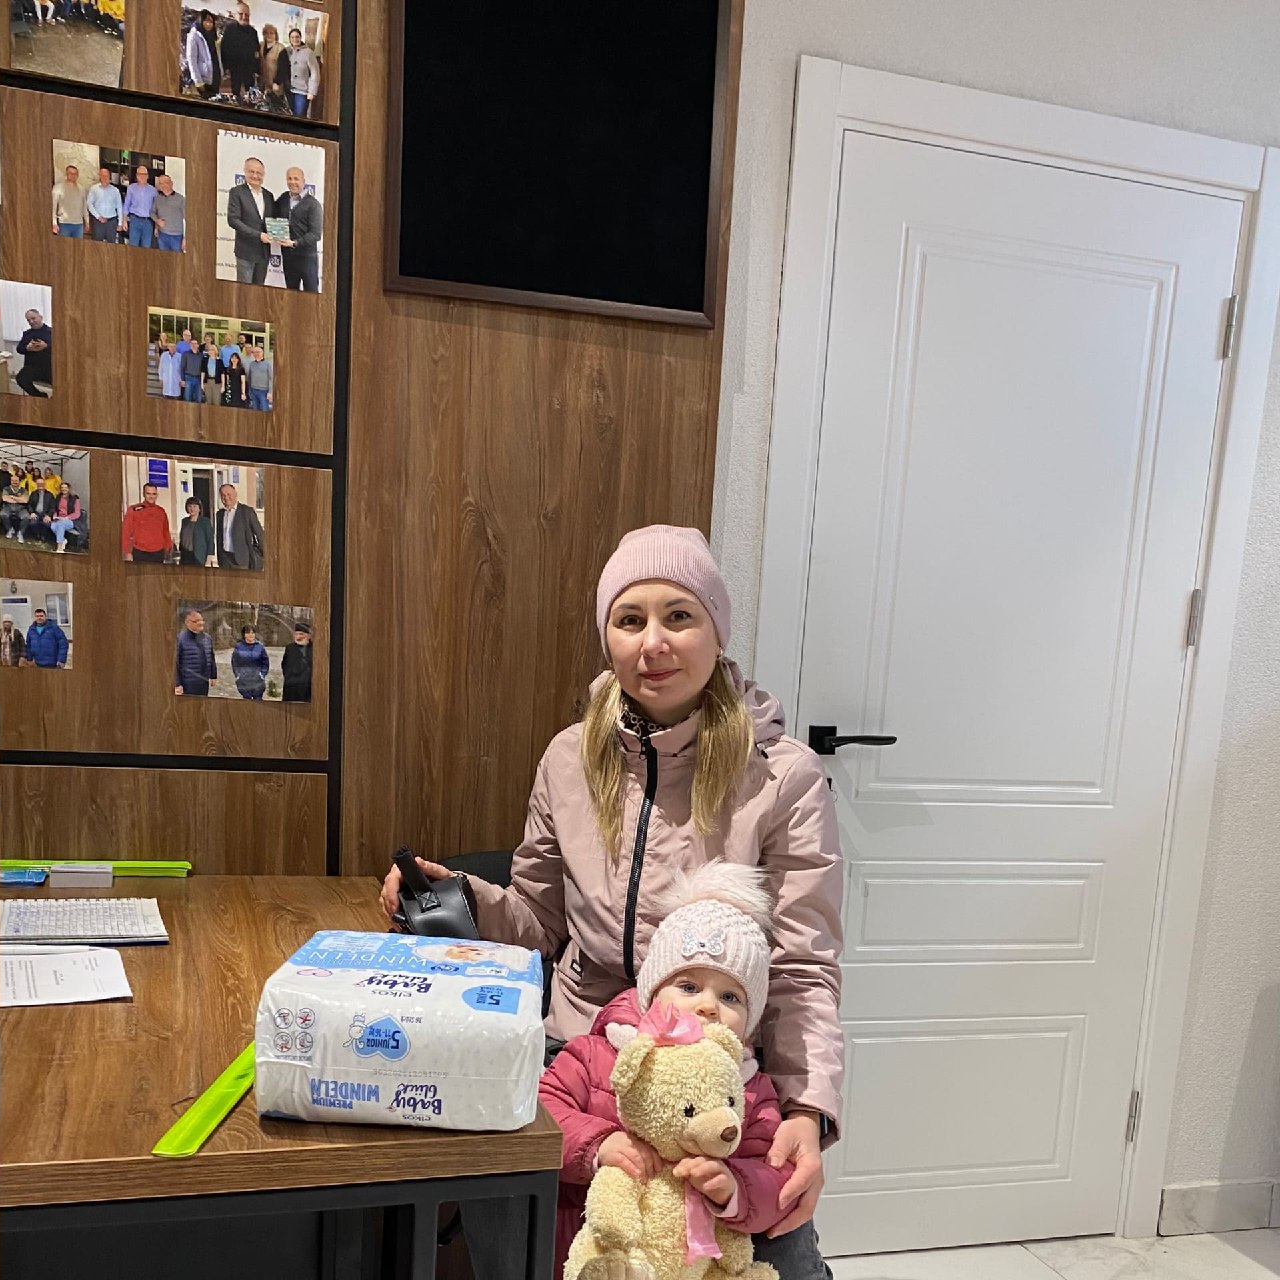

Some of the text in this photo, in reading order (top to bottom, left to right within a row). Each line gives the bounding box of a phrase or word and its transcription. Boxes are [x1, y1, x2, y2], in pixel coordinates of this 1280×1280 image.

[364, 976, 433, 994] Baby
[487, 994, 502, 1006] 5
[365, 1030, 401, 1050] 5 JUNIOR
[310, 1078, 380, 1103] WINDELN
[396, 1083, 438, 1099] Glück
[312, 1097, 354, 1110] PREMIUM
[394, 1090, 442, 1115] Baby
